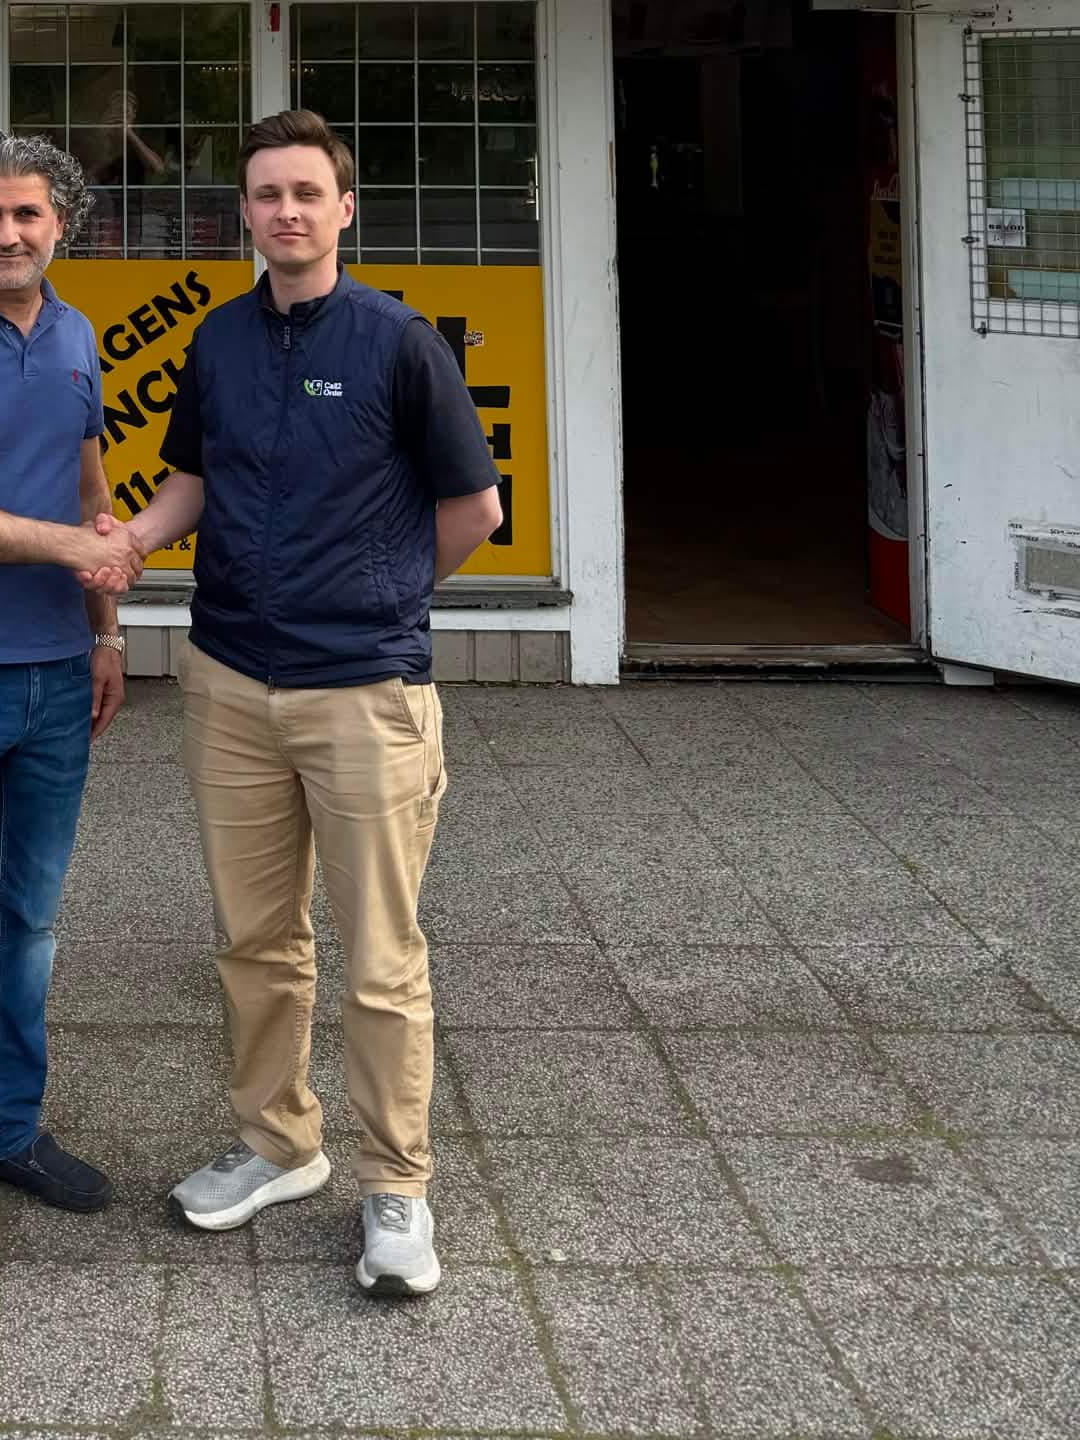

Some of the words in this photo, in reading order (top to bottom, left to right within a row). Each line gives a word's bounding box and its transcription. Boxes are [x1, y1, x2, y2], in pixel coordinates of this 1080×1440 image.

[100, 270, 211, 374] GENS
[100, 348, 190, 455] NC
[323, 389, 343, 397] Order
